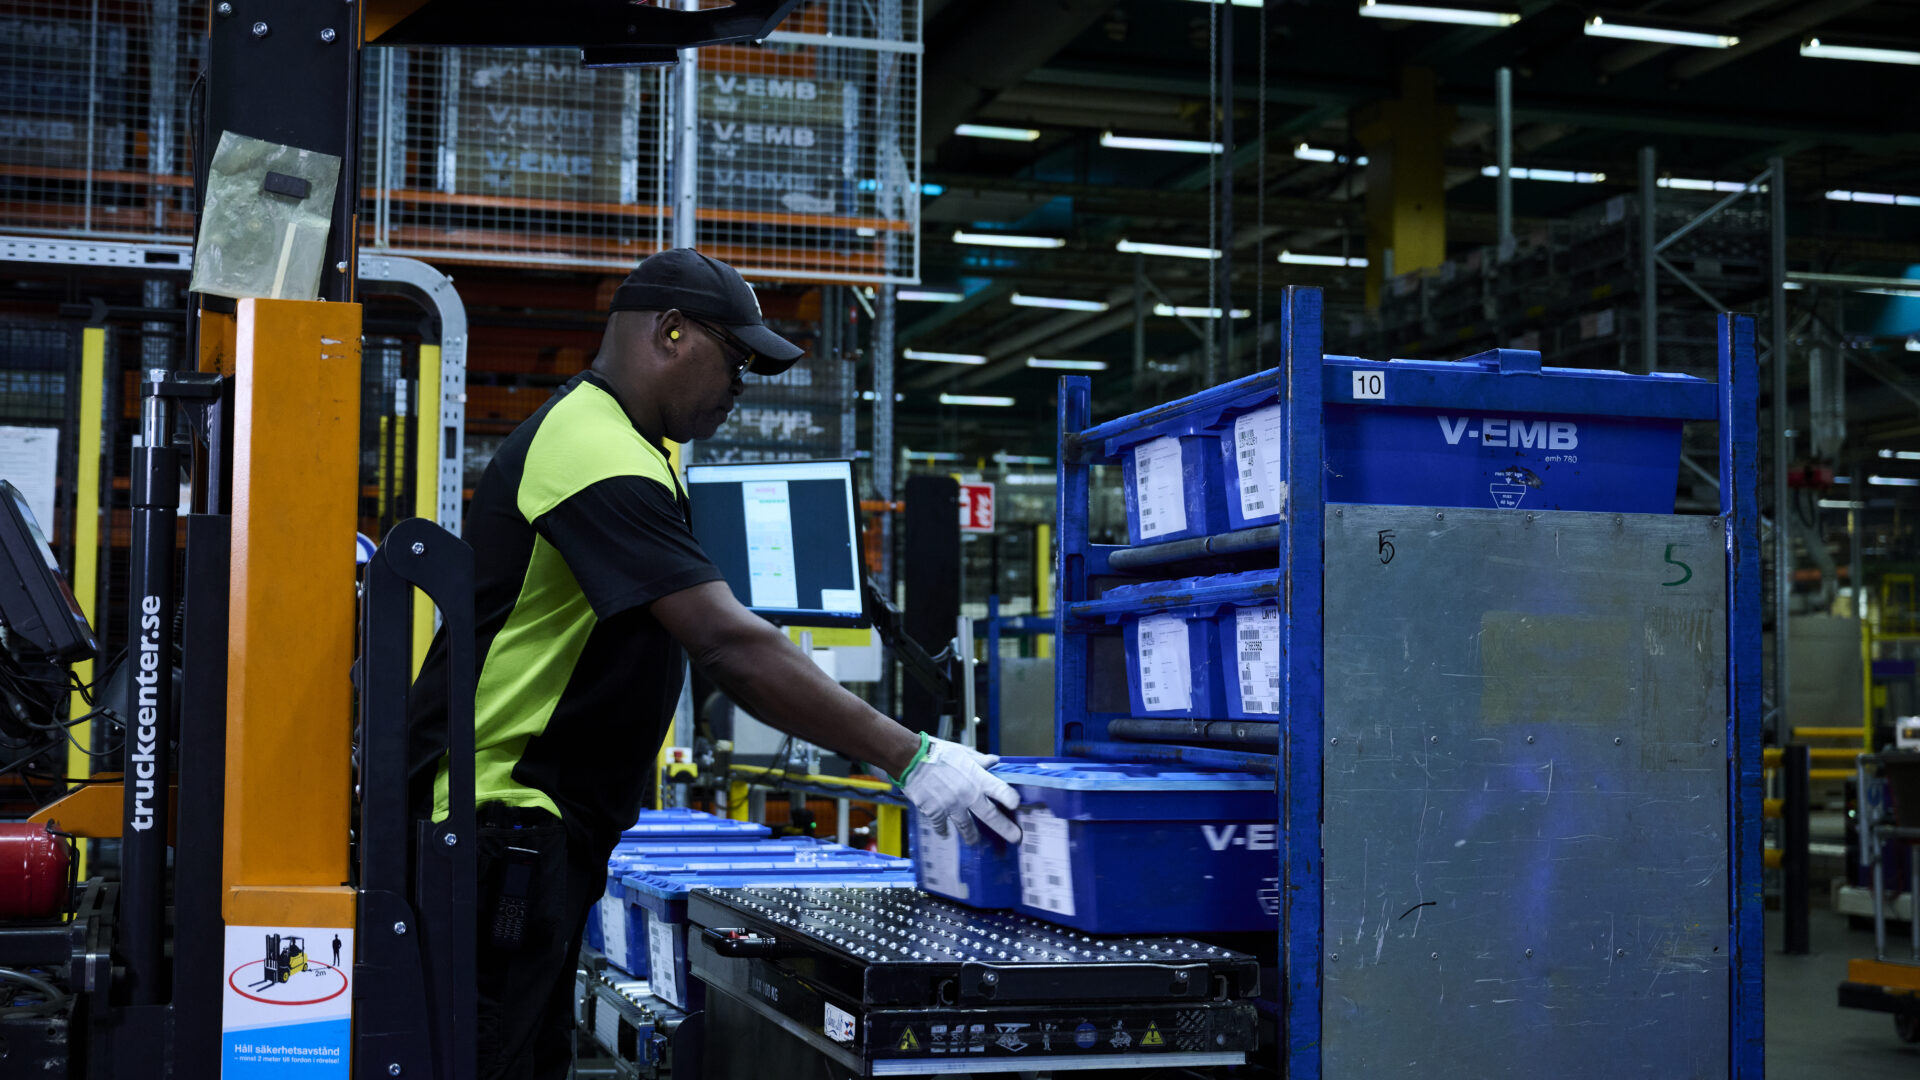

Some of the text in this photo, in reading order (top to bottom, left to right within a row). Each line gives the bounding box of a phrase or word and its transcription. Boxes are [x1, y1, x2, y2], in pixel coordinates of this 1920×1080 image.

[715, 75, 817, 100] V-EMB
[712, 121, 815, 148] V-EMB
[1356, 375, 1382, 396] 10
[1437, 415, 1578, 451] V-EMB
[1563, 455, 1578, 464] 780
[1661, 543, 1693, 587] 5
[130, 595, 161, 832] truckcenter.se
[1199, 823, 1279, 851] V-E
[234, 1043, 340, 1056] Håll säkerhetsavstånd
